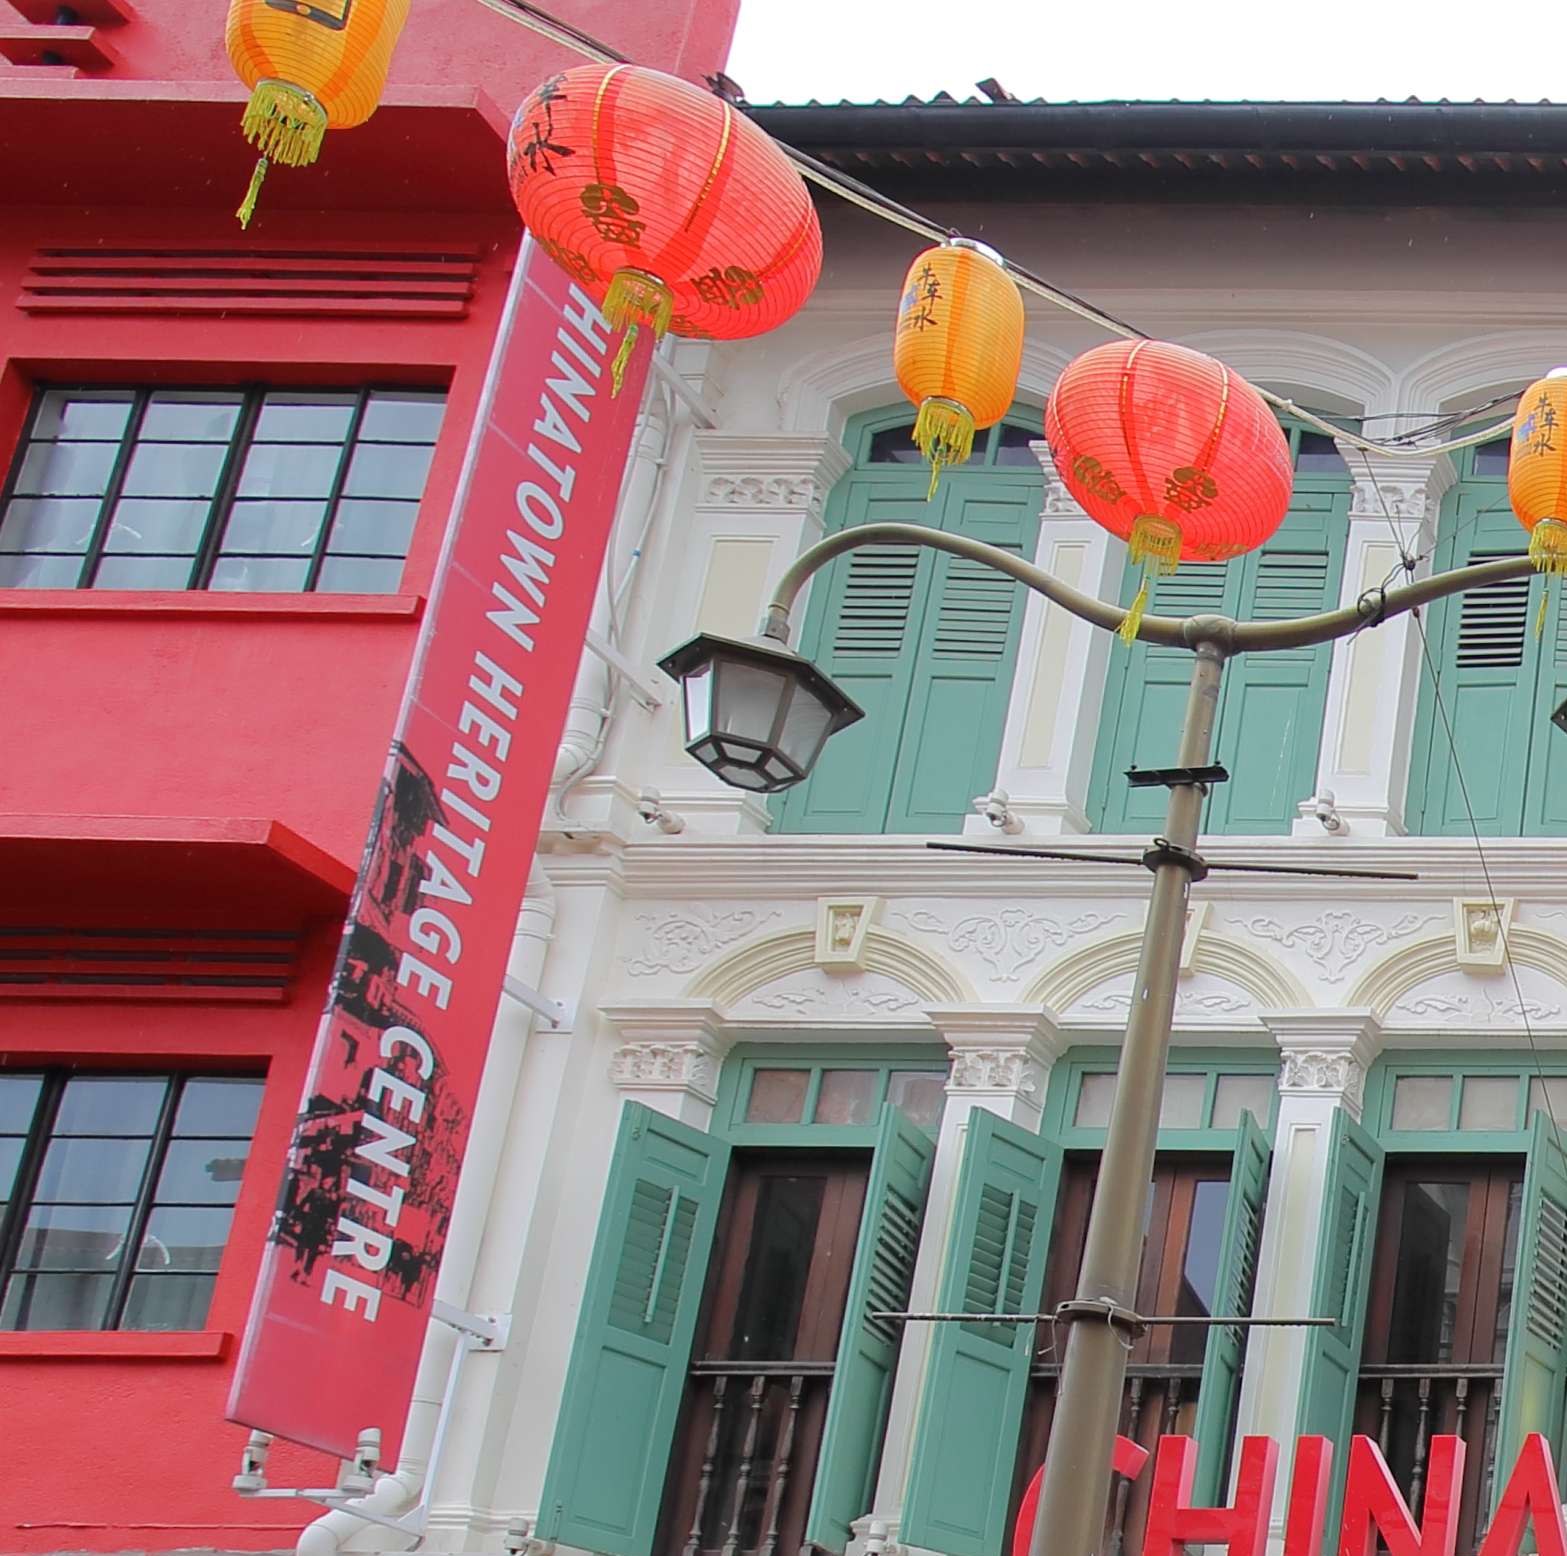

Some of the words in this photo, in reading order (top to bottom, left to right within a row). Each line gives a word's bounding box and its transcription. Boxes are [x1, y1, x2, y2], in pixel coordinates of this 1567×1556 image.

[485, 282, 614, 653] HINATOWN
[399, 650, 525, 1011] HERITAGE
[319, 1023, 435, 1323] CENTRE
